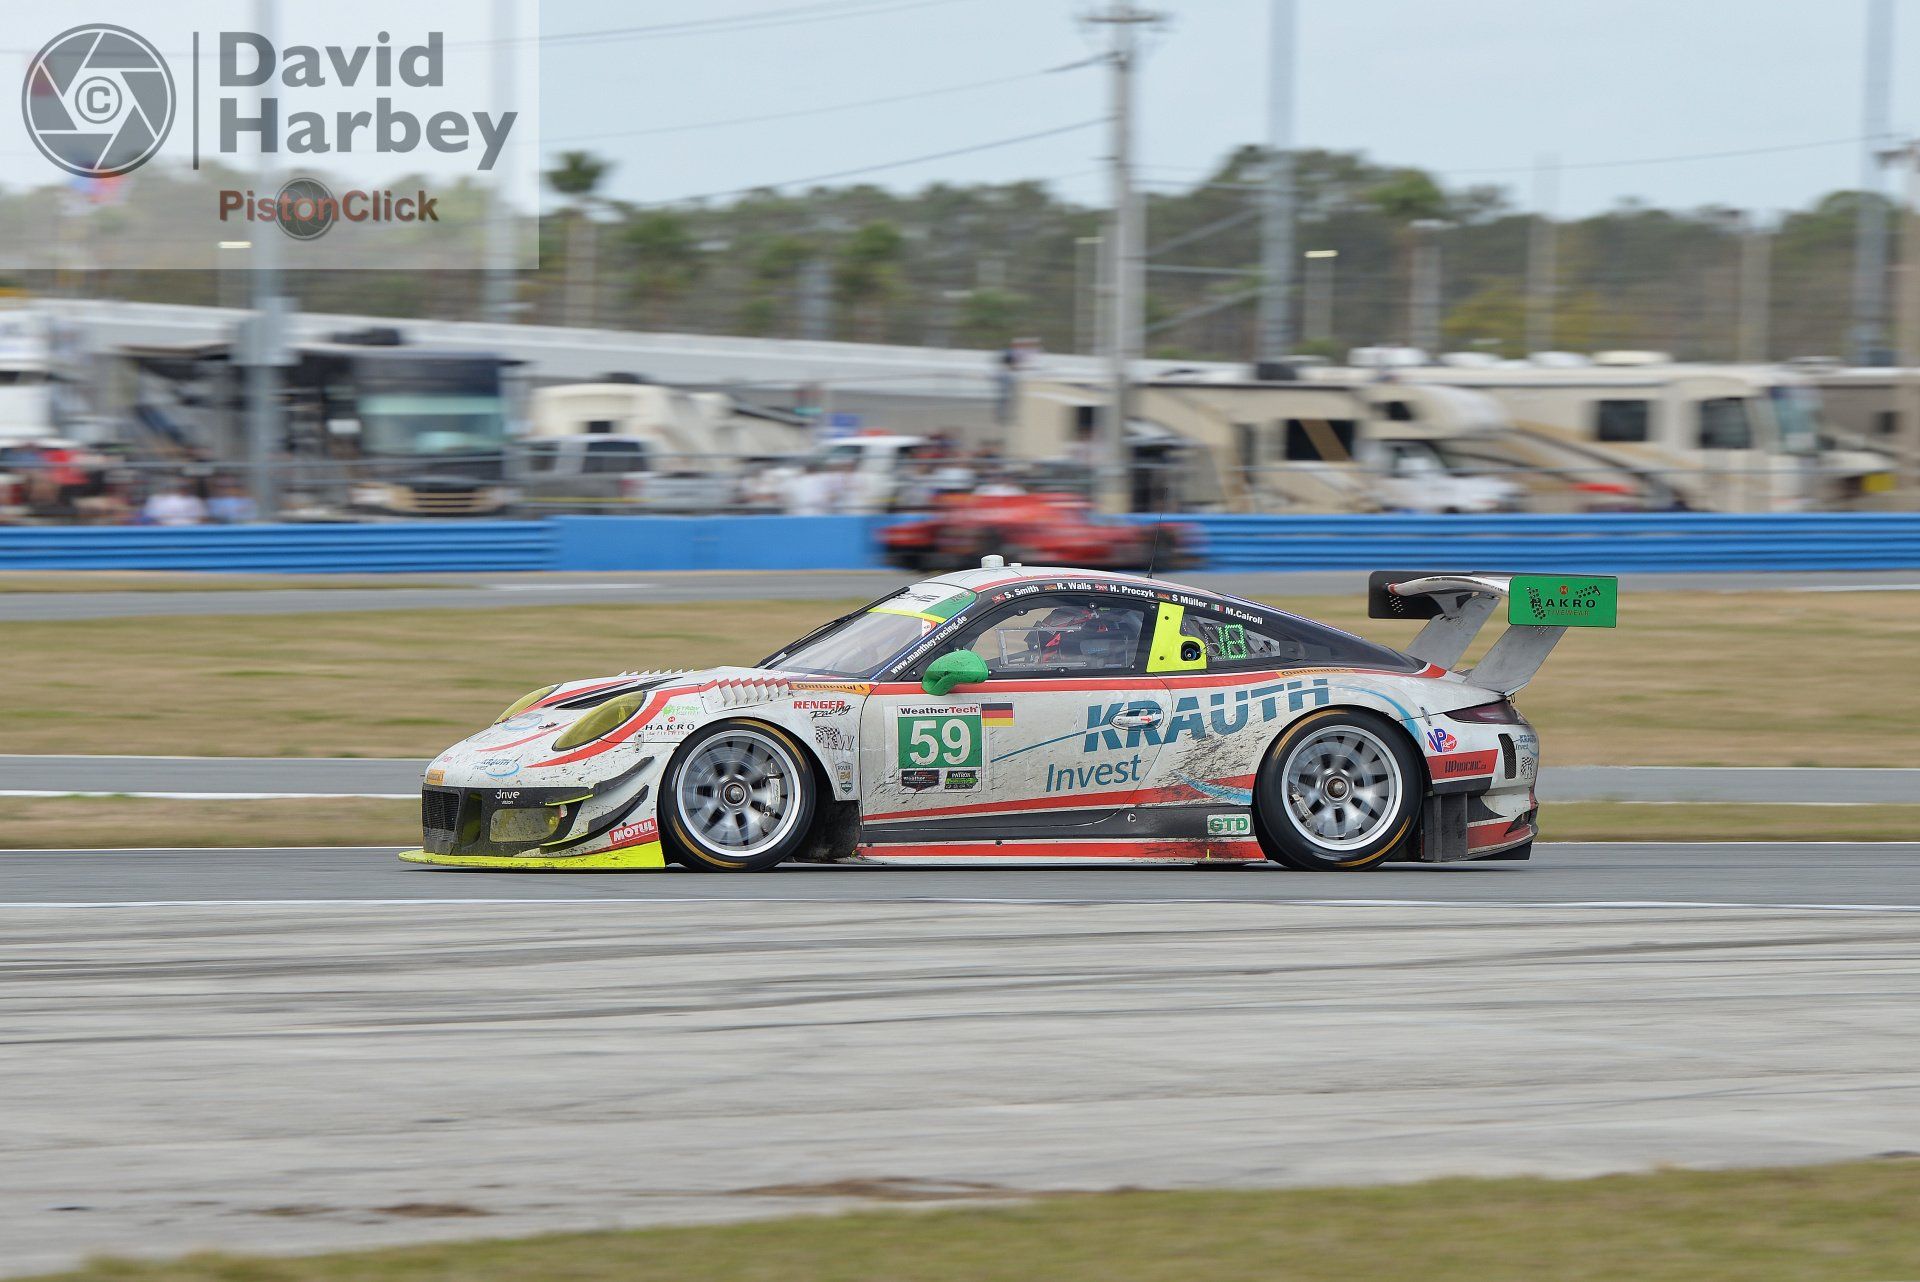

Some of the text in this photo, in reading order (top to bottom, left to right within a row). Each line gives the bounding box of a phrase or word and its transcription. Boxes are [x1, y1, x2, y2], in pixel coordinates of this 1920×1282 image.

[1015, 585, 1040, 596] Smith
[1068, 582, 1092, 590] Walls
[1110, 584, 1155, 598] H. Proczyk
[1180, 595, 1208, 608] Müller
[890, 615, 968, 674] www.manthey-racing.de
[793, 700, 845, 710] RENGER
[810, 704, 856, 721] Racing
[900, 706, 978, 715] WeatherTech
[1083, 678, 1330, 753] KRAUTH
[645, 723, 695, 731] HAKRO
[909, 718, 971, 766] 59
[1426, 728, 1447, 752] VP
[1045, 754, 1142, 793] Invest
[495, 789, 520, 799] drive
[613, 821, 655, 842] MOTUL
[1209, 816, 1249, 832] GTD
